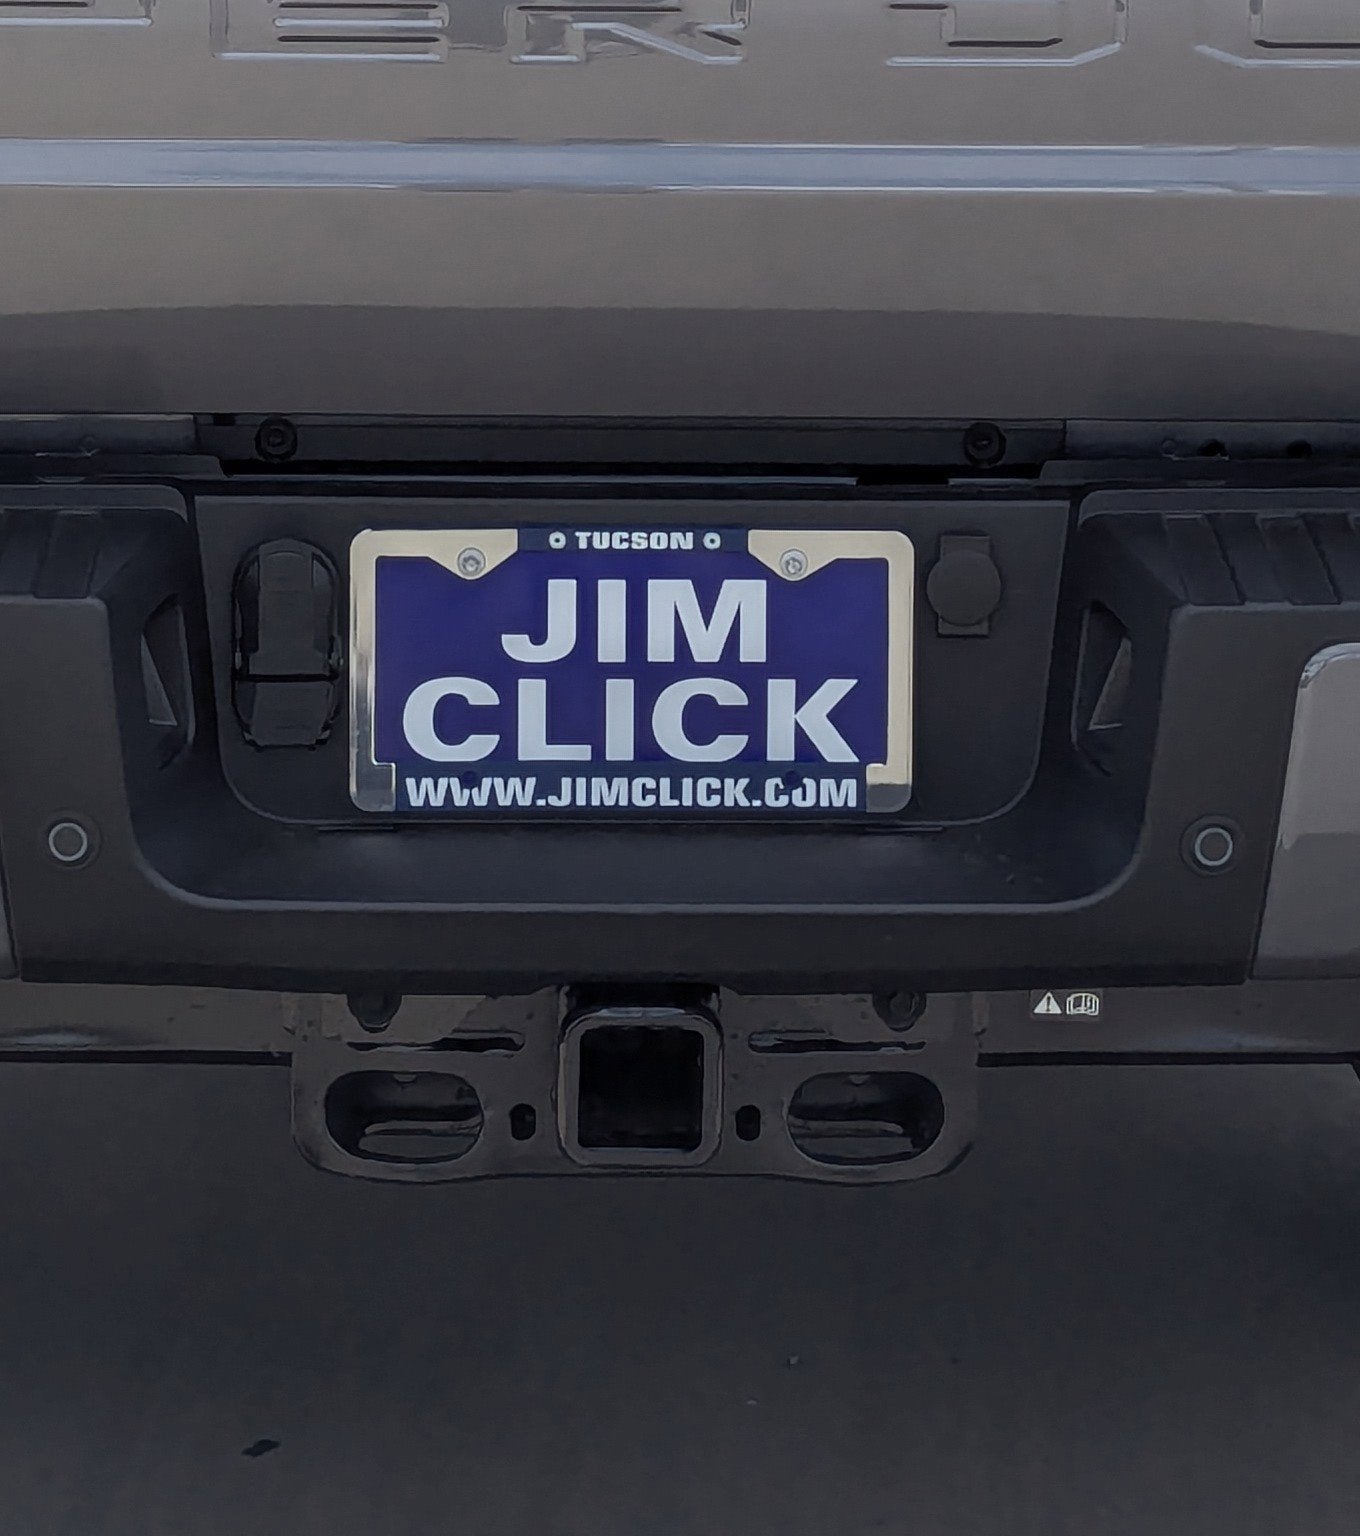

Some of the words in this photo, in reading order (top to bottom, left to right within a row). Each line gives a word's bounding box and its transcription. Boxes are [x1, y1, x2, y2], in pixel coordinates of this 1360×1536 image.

[574, 531, 694, 550] TUCSON
[501, 578, 767, 663] JIM
[402, 677, 860, 762] CLICK
[405, 776, 858, 808] WWW.JIMCLICK.COM
